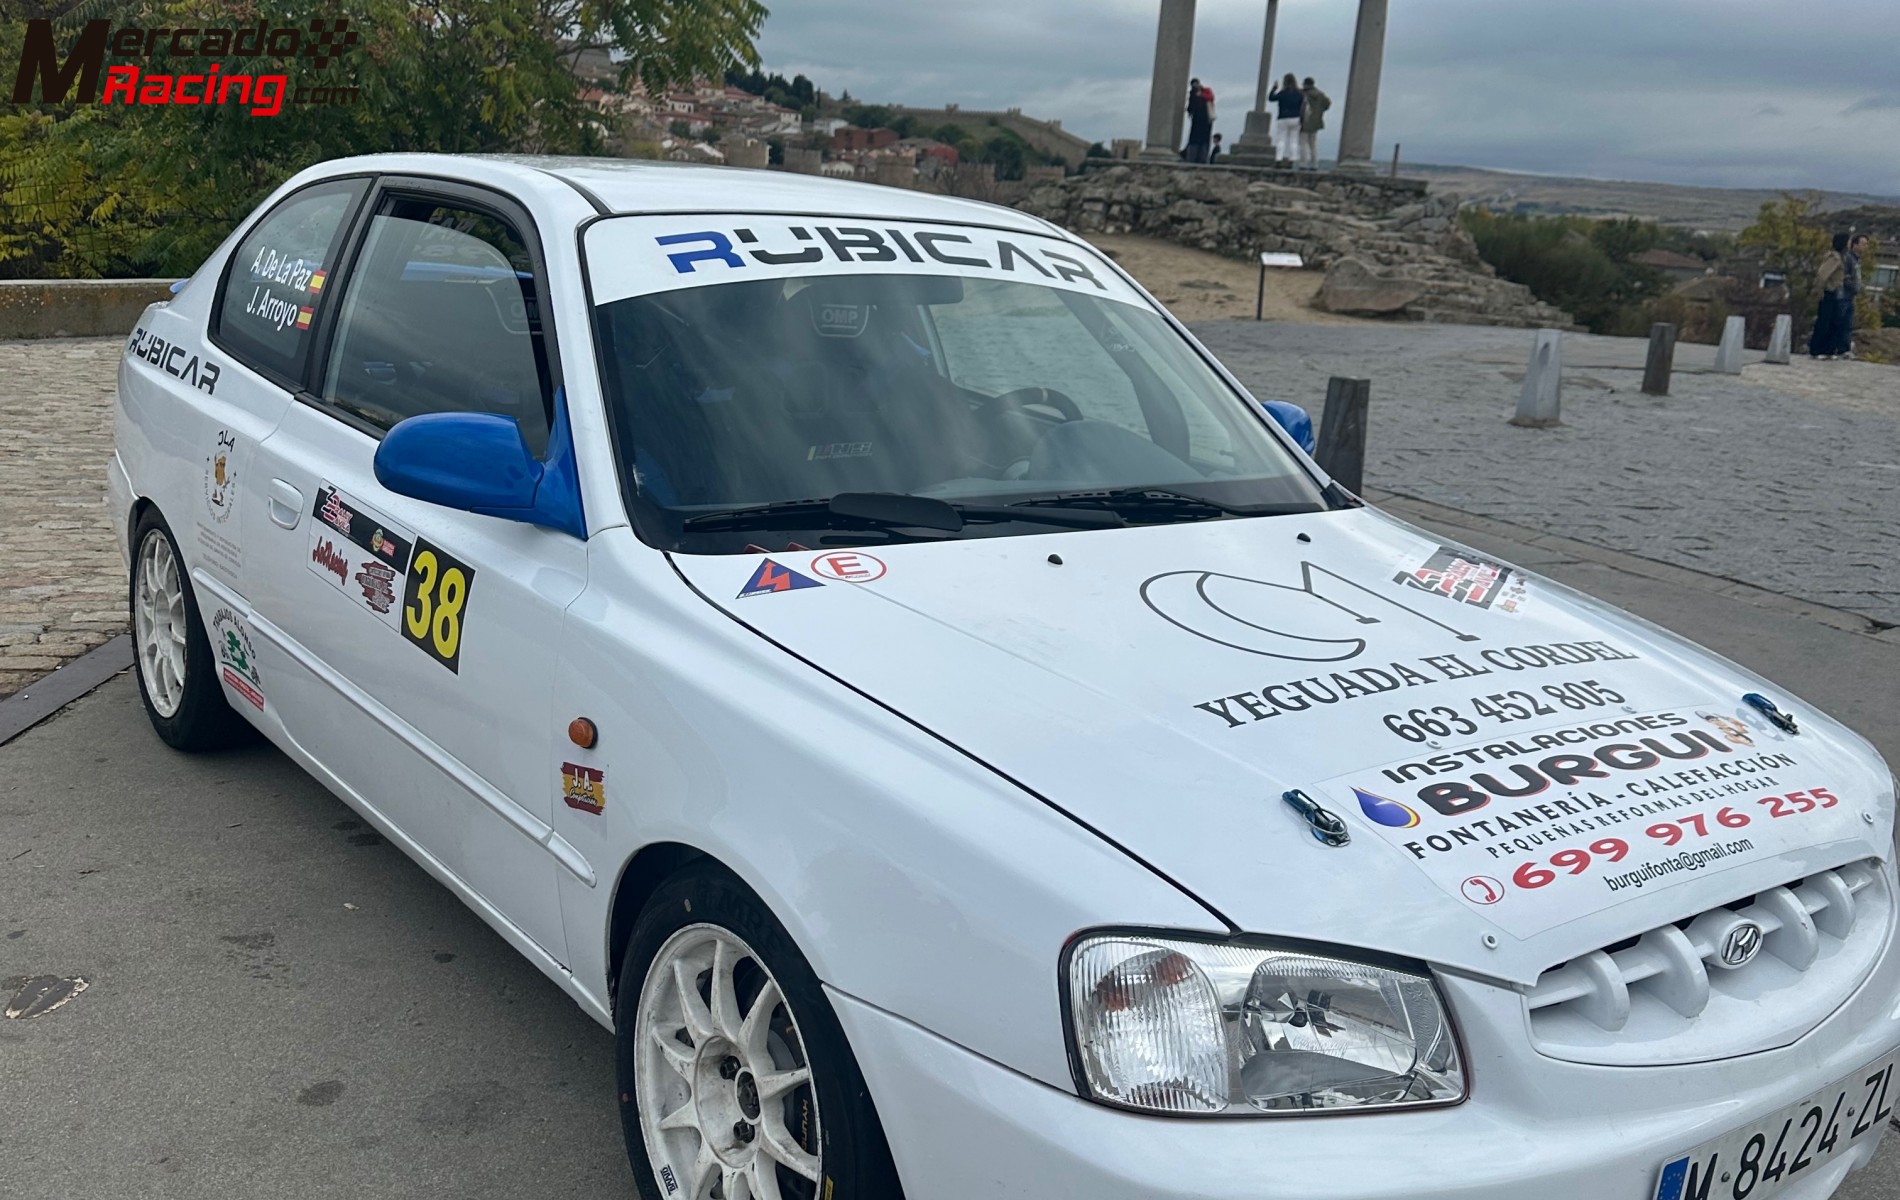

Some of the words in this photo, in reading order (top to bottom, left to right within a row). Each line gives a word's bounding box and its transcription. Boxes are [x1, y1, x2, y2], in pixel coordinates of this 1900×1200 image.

[262, 249, 276, 280] De
[275, 254, 290, 285] La
[289, 258, 312, 292] Paz
[655, 227, 1108, 291] RUBICAR
[246, 286, 260, 314] J.
[259, 289, 298, 331] Arroyo
[821, 307, 858, 324] OMP
[129, 328, 221, 395] RUBICAR
[827, 556, 869, 576] E
[406, 550, 465, 658] 38
[1193, 662, 1437, 728] YEGUADA
[1418, 654, 1494, 680] EL
[1480, 641, 1640, 671] CORDEL
[1383, 706, 1478, 742] 663
[1470, 690, 1558, 723] 452
[1541, 680, 1626, 710] 805
[1381, 712, 1688, 784] INSTALACIONES
[1417, 730, 1734, 816] BURGUI
[1403, 792, 1613, 860] FONTANERÍA
[1625, 753, 1798, 797] CALEFACCIÓN
[1485, 815, 1596, 858] PEQUEÑAS
[1594, 793, 1692, 827] REFORMAS
[1691, 786, 1725, 802] DEL
[1727, 775, 1780, 795] HOGAR
[1512, 838, 1629, 889] 699
[1645, 806, 1751, 846] 976
[1756, 787, 1839, 818] 255
[1603, 838, 1754, 892] burguifonta@gmail.com
[1732, 1091, 1846, 1200] 8424
[1851, 1063, 1894, 1139] ZL
